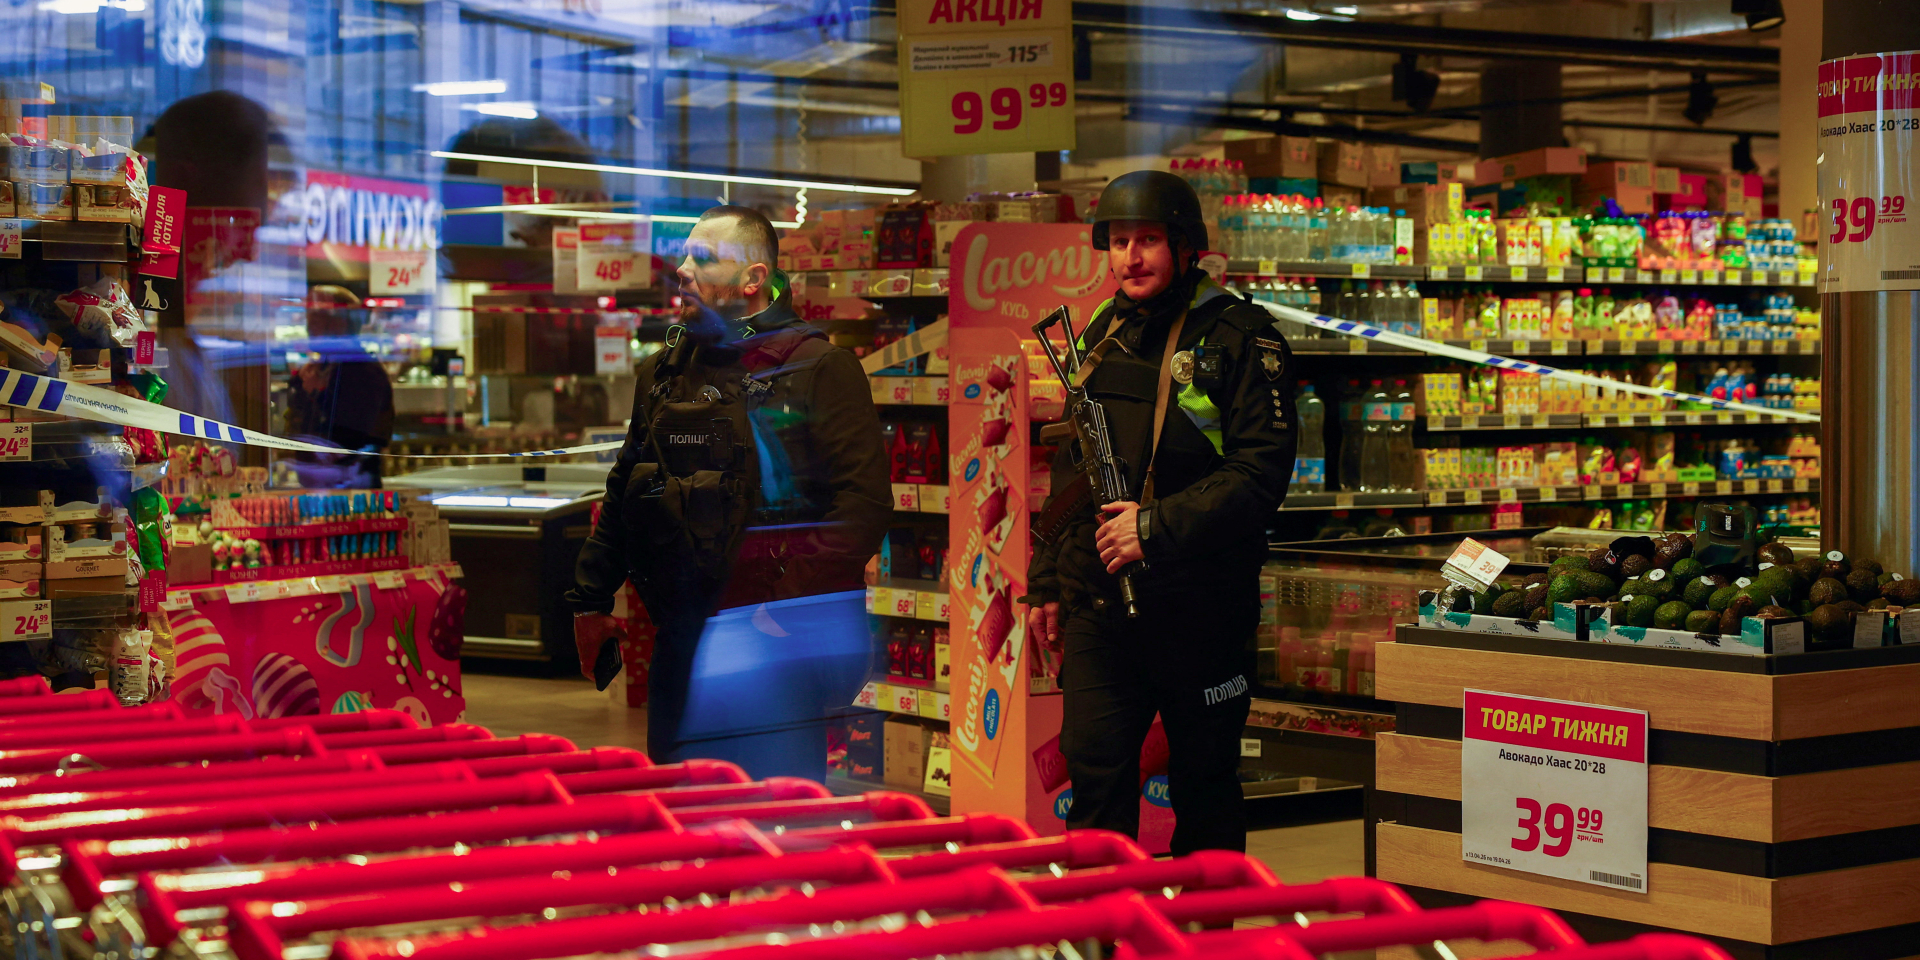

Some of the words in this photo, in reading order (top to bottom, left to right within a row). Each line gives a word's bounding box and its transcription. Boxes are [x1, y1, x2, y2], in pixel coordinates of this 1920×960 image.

[928, 0, 1042, 26] АКЦІЯ
[1008, 45, 1038, 63] 115
[1819, 78, 1850, 98] ТОВАР
[1820, 126, 1846, 138] Авокадо
[1849, 122, 1875, 134] Хаас
[1830, 197, 1875, 244] 39
[1879, 196, 1904, 214] 99
[150, 220, 163, 264] ТОАРИ
[596, 260, 622, 280] 48
[963, 231, 1094, 312] Lacmi
[802, 300, 834, 320] der
[1001, 301, 1029, 319] КУСЬ
[894, 387, 906, 400] 68
[900, 494, 912, 506] 68
[897, 599, 909, 612] 68
[14, 616, 39, 635] 24
[1204, 674, 1248, 706] ПОЛІЦІЯ
[900, 697, 911, 710] 68
[956, 662, 983, 752] Lacmi
[1480, 707, 1546, 735] ТОВАР
[1551, 716, 1629, 747] ТИЖНЯ
[1499, 748, 1544, 766] Авокадо
[1546, 755, 1572, 769] Хаас
[1148, 780, 1170, 799] КУС
[1511, 797, 1574, 857] 39
[1576, 807, 1603, 831] 99
[1576, 834, 1604, 844] грн/шт
